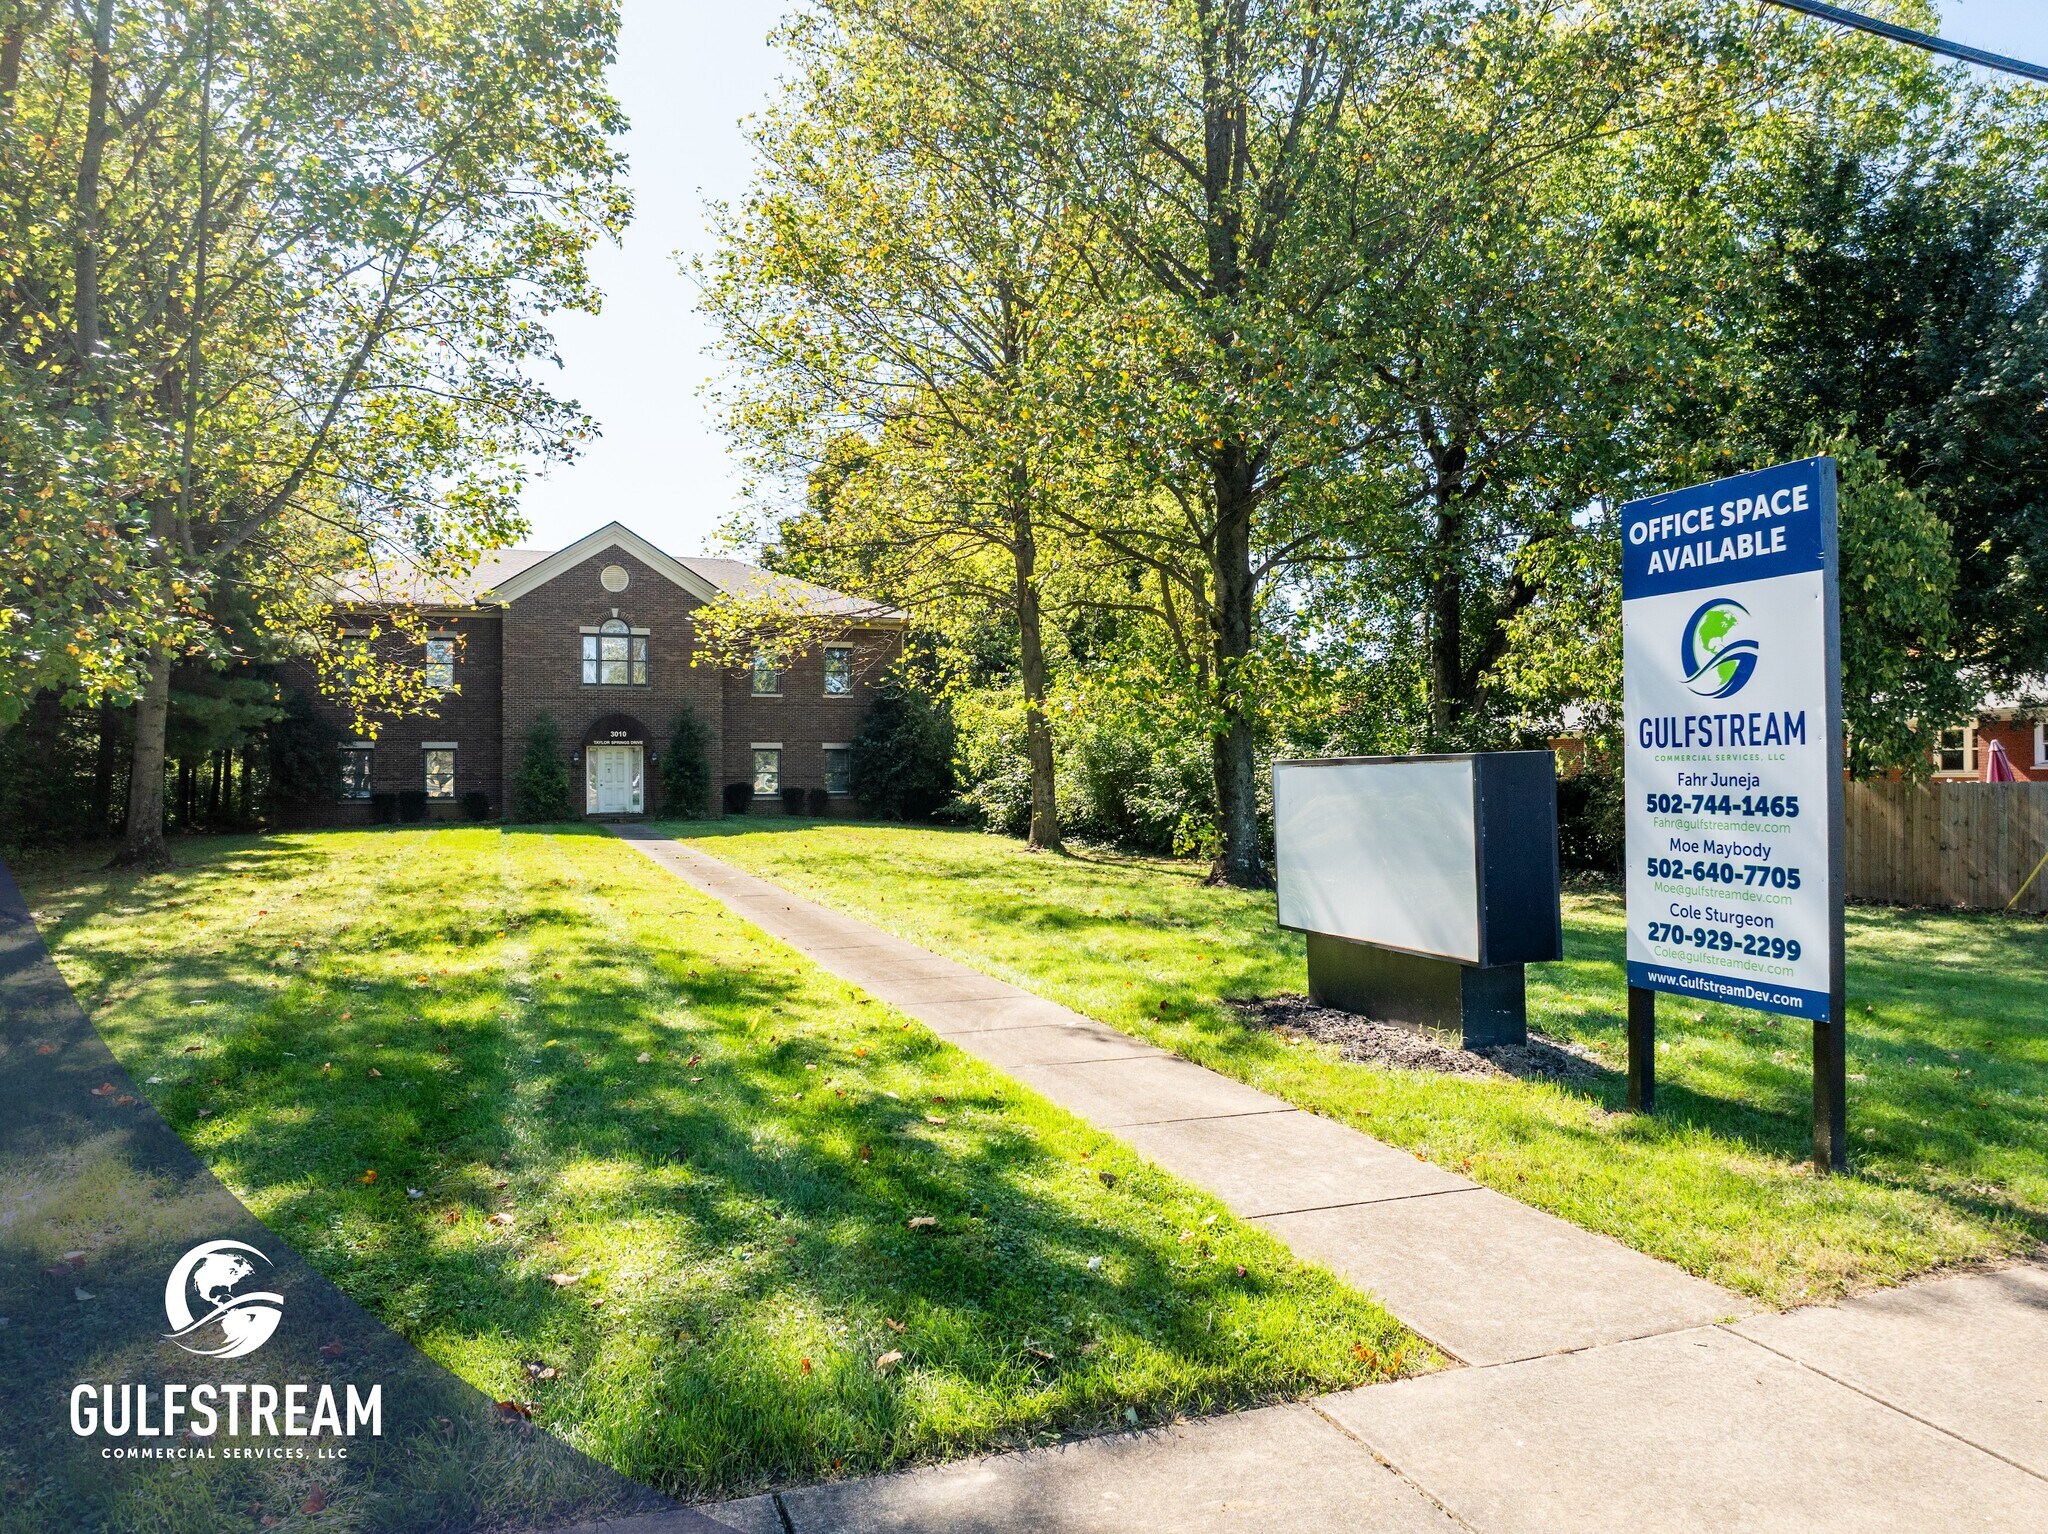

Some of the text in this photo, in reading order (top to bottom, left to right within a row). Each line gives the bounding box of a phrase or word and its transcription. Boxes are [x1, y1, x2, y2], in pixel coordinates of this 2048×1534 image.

[1629, 484, 1809, 545] OFFICE SPACE
[1647, 525, 1787, 575] AVAILABLE
[1639, 710, 1806, 749] GULFSTREAM
[1654, 753, 1786, 762] COMMERCIAL SERVICES, LLC
[1678, 772, 1760, 791] Fahr Juneja
[1646, 794, 1799, 818] 502-744-1465
[1653, 817, 1791, 834] Fahr@gulfstreamdev.com
[1670, 837, 1772, 860] Moe Maybody
[1647, 858, 1801, 890] 502-640-7705
[1654, 881, 1793, 906] Moe@gulfstreamdev.com
[1670, 903, 1774, 929] Cole Sturgeon
[1648, 922, 1802, 961] 270-929-2299
[1654, 946, 1794, 977] Cole@gulfstreamdev.com
[1648, 972, 1803, 1008] www.GulfstreamDev.com
